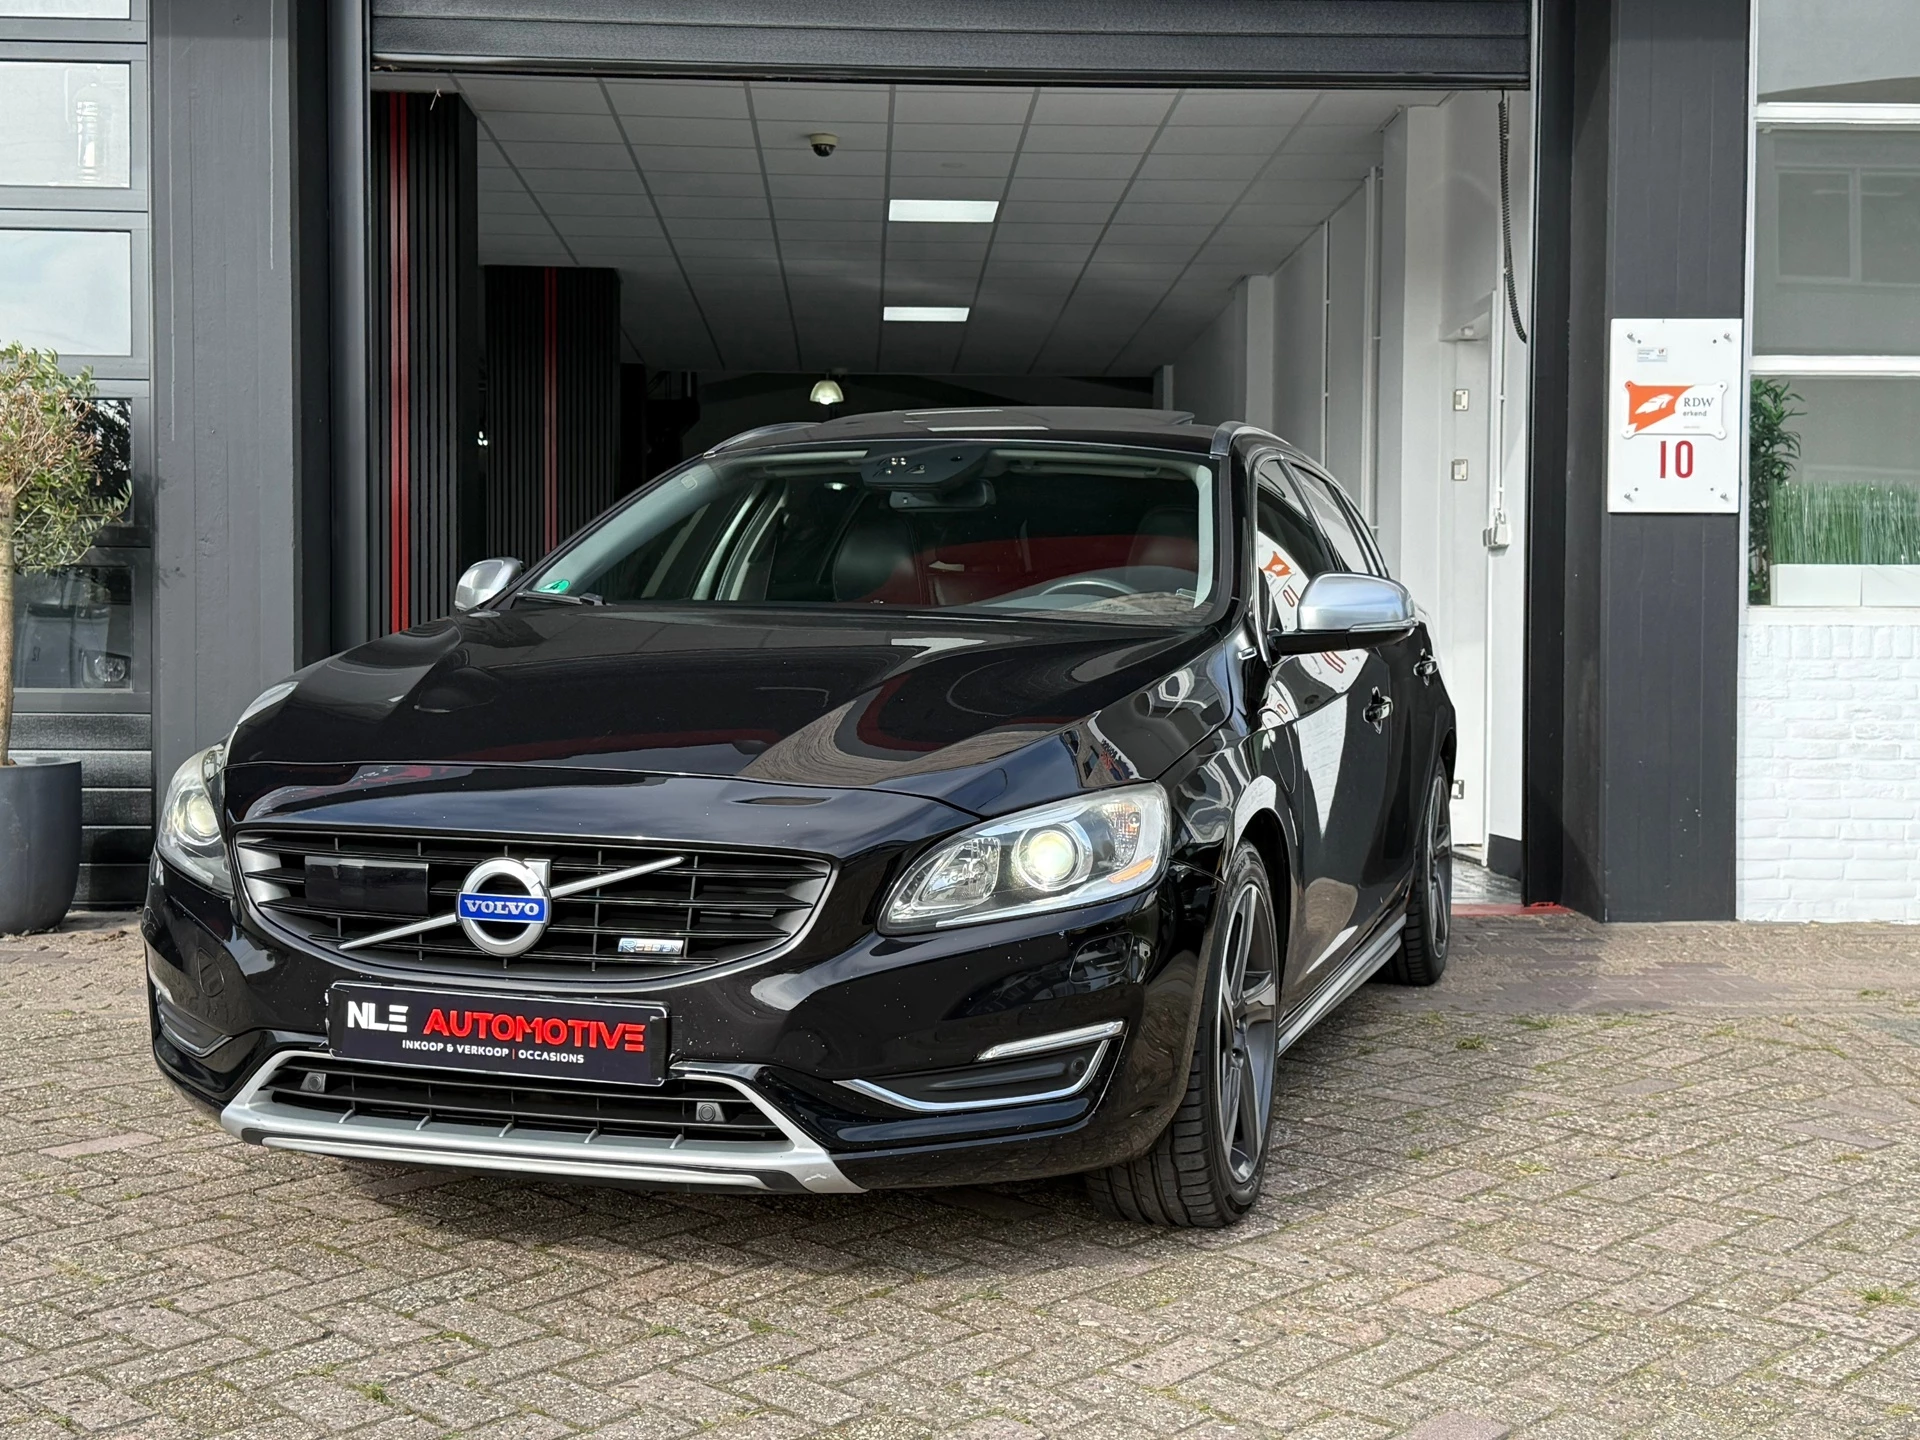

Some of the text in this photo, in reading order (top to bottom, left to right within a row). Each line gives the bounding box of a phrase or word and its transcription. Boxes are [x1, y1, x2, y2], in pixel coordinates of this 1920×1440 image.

[1683, 397, 1714, 407] RDW
[1660, 440, 1694, 479] 10
[464, 899, 540, 917] VOLVO
[347, 1001, 646, 1053] NLE AUTOMOTIVE
[402, 1039, 445, 1053] INKOOP
[446, 1043, 454, 1053] &
[456, 1044, 509, 1058] VERKOOP
[517, 1050, 585, 1064] OCCASIONS
